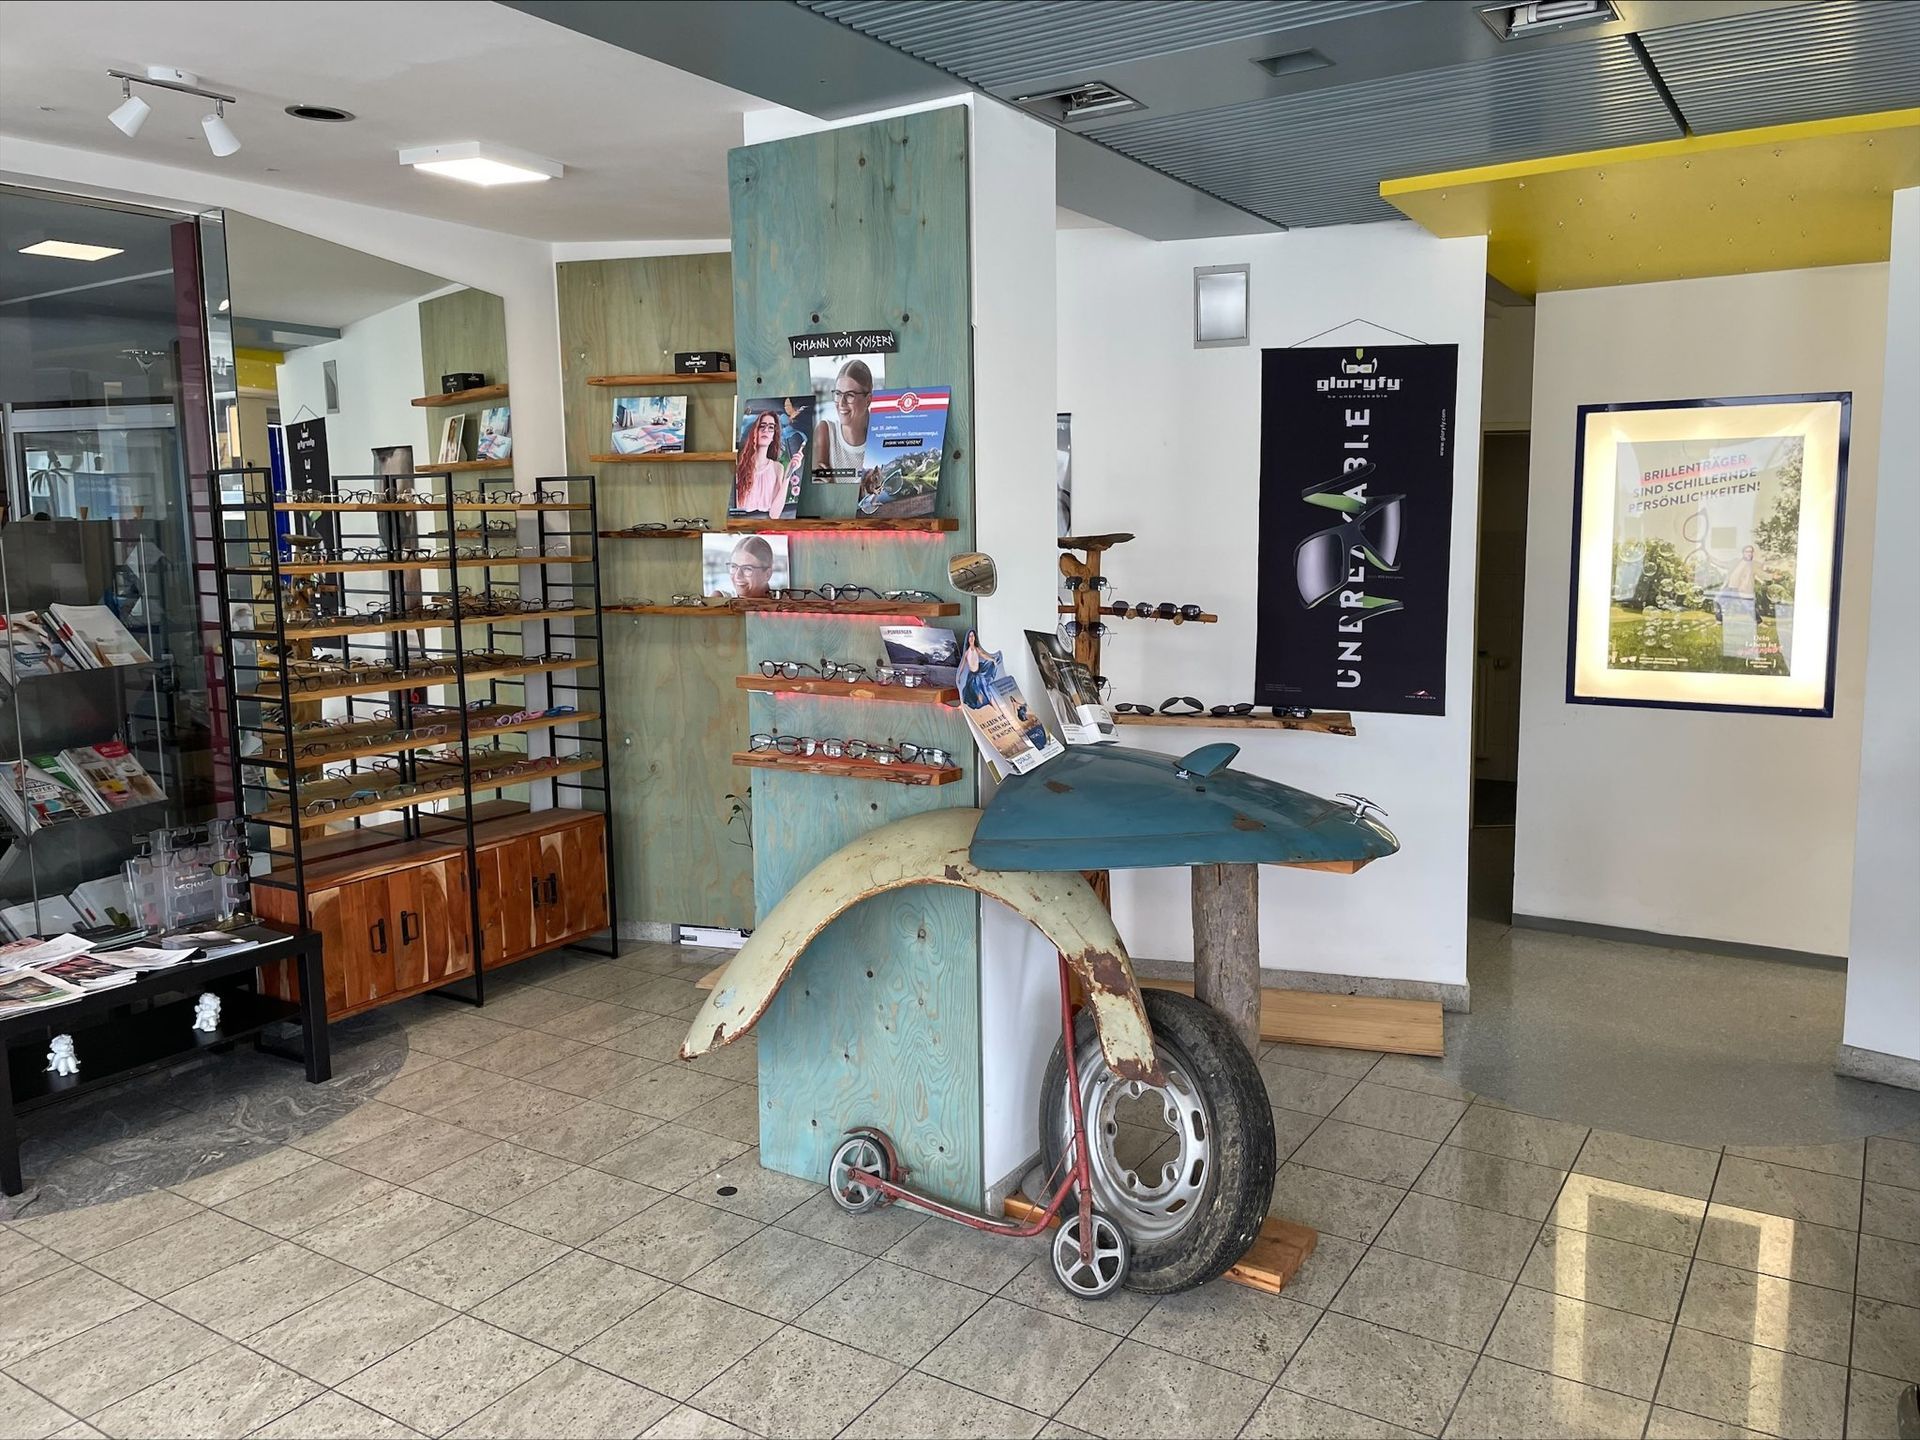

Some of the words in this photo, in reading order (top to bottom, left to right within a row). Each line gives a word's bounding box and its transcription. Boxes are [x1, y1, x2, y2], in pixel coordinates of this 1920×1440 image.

[793, 338, 830, 356] JOHANN
[833, 336, 852, 348] VON
[856, 332, 895, 352] GOISERN
[1316, 376, 1400, 391] gloryfy
[1644, 454, 1747, 481] BRILLENTRÄGER
[1633, 484, 1663, 498] SIND
[1667, 467, 1758, 492] SCHILLERNDE
[1628, 481, 1760, 512] PERSÖNLICHKEITEN!
